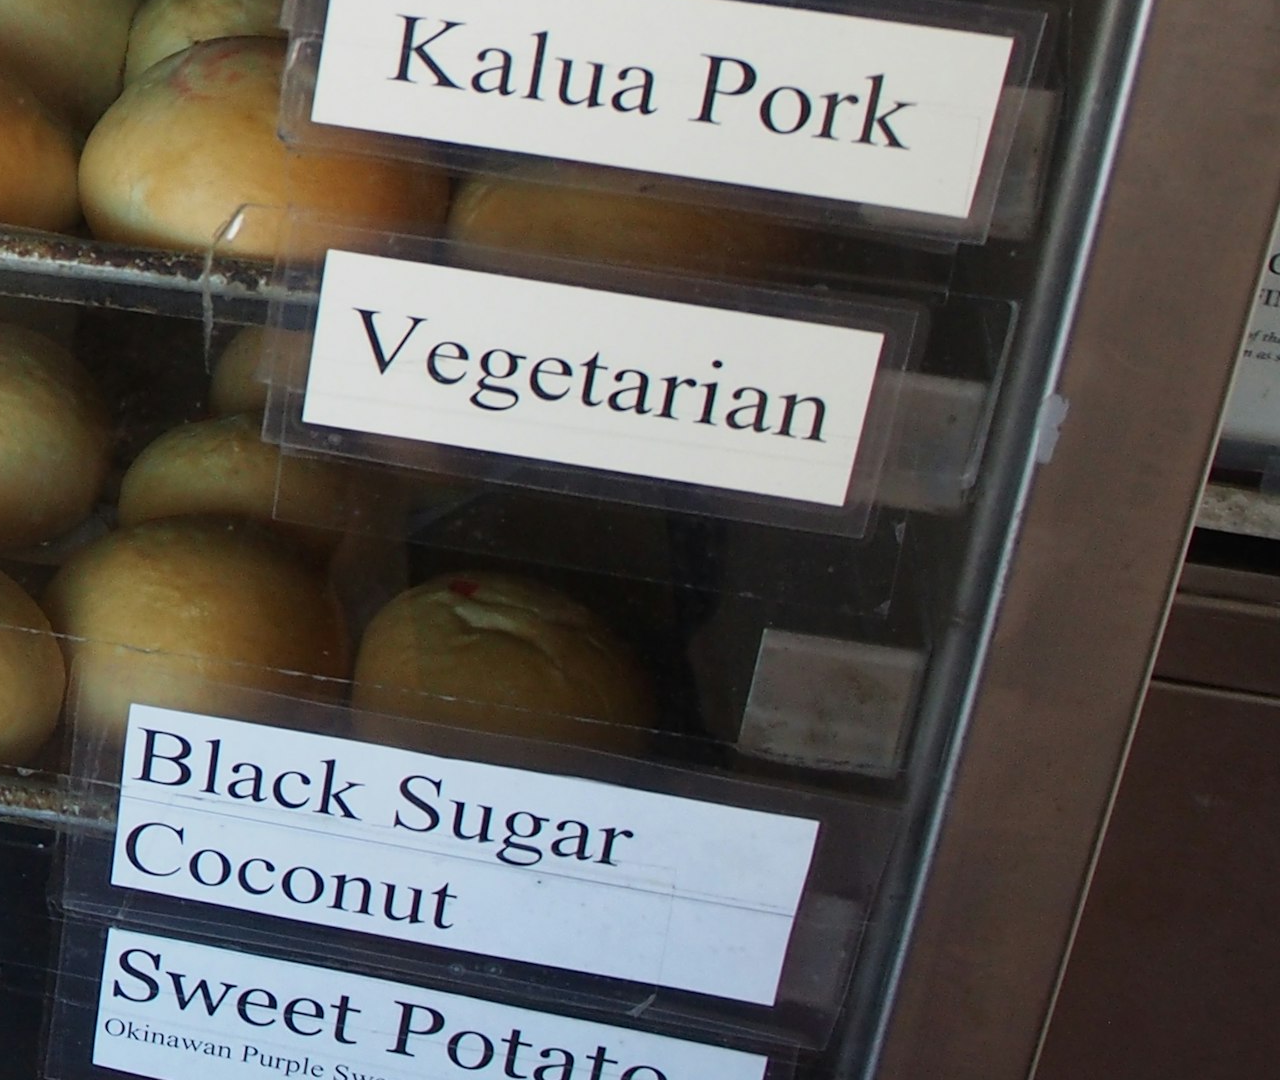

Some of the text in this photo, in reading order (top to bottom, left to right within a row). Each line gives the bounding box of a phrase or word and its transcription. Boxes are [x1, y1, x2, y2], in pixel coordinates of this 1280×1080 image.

[387, 15, 911, 150] Kalua Pork
[355, 308, 826, 443] Vegetarian
[136, 727, 634, 867] Black Sugar
[125, 822, 458, 930] Coconut
[104, 1018, 231, 1059] Okinawan
[242, 1045, 324, 1078] Purple
[112, 948, 362, 1045] Sweet
